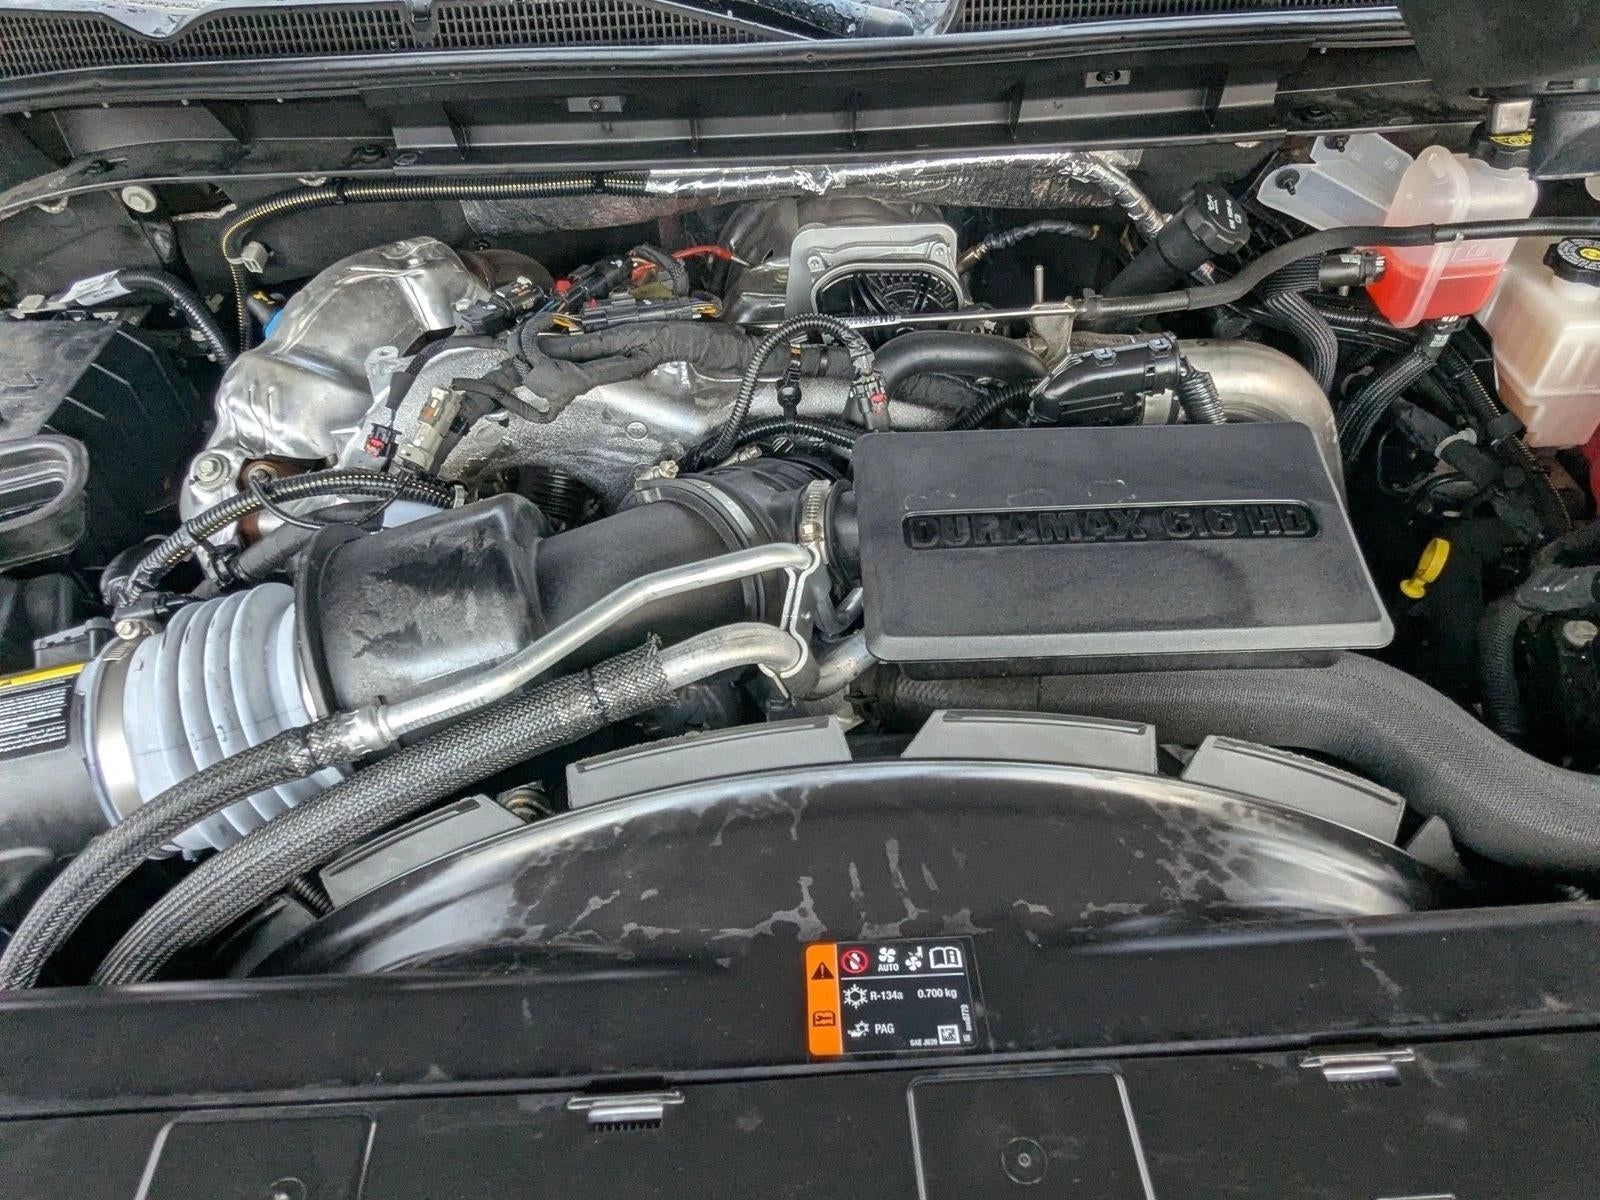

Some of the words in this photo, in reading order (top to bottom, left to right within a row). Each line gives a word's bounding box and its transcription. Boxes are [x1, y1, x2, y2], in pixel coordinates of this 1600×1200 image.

[909, 509, 1148, 548] DURAMAX
[1164, 505, 1238, 538] 6.6
[1246, 503, 1311, 536] HD
[878, 963, 899, 972] AUTO
[870, 990, 904, 1001] R-134a
[917, 988, 943, 999] 0.700
[944, 988, 958, 1000] kg
[874, 1023, 895, 1034] PAG
[909, 1038, 922, 1047] SAE
